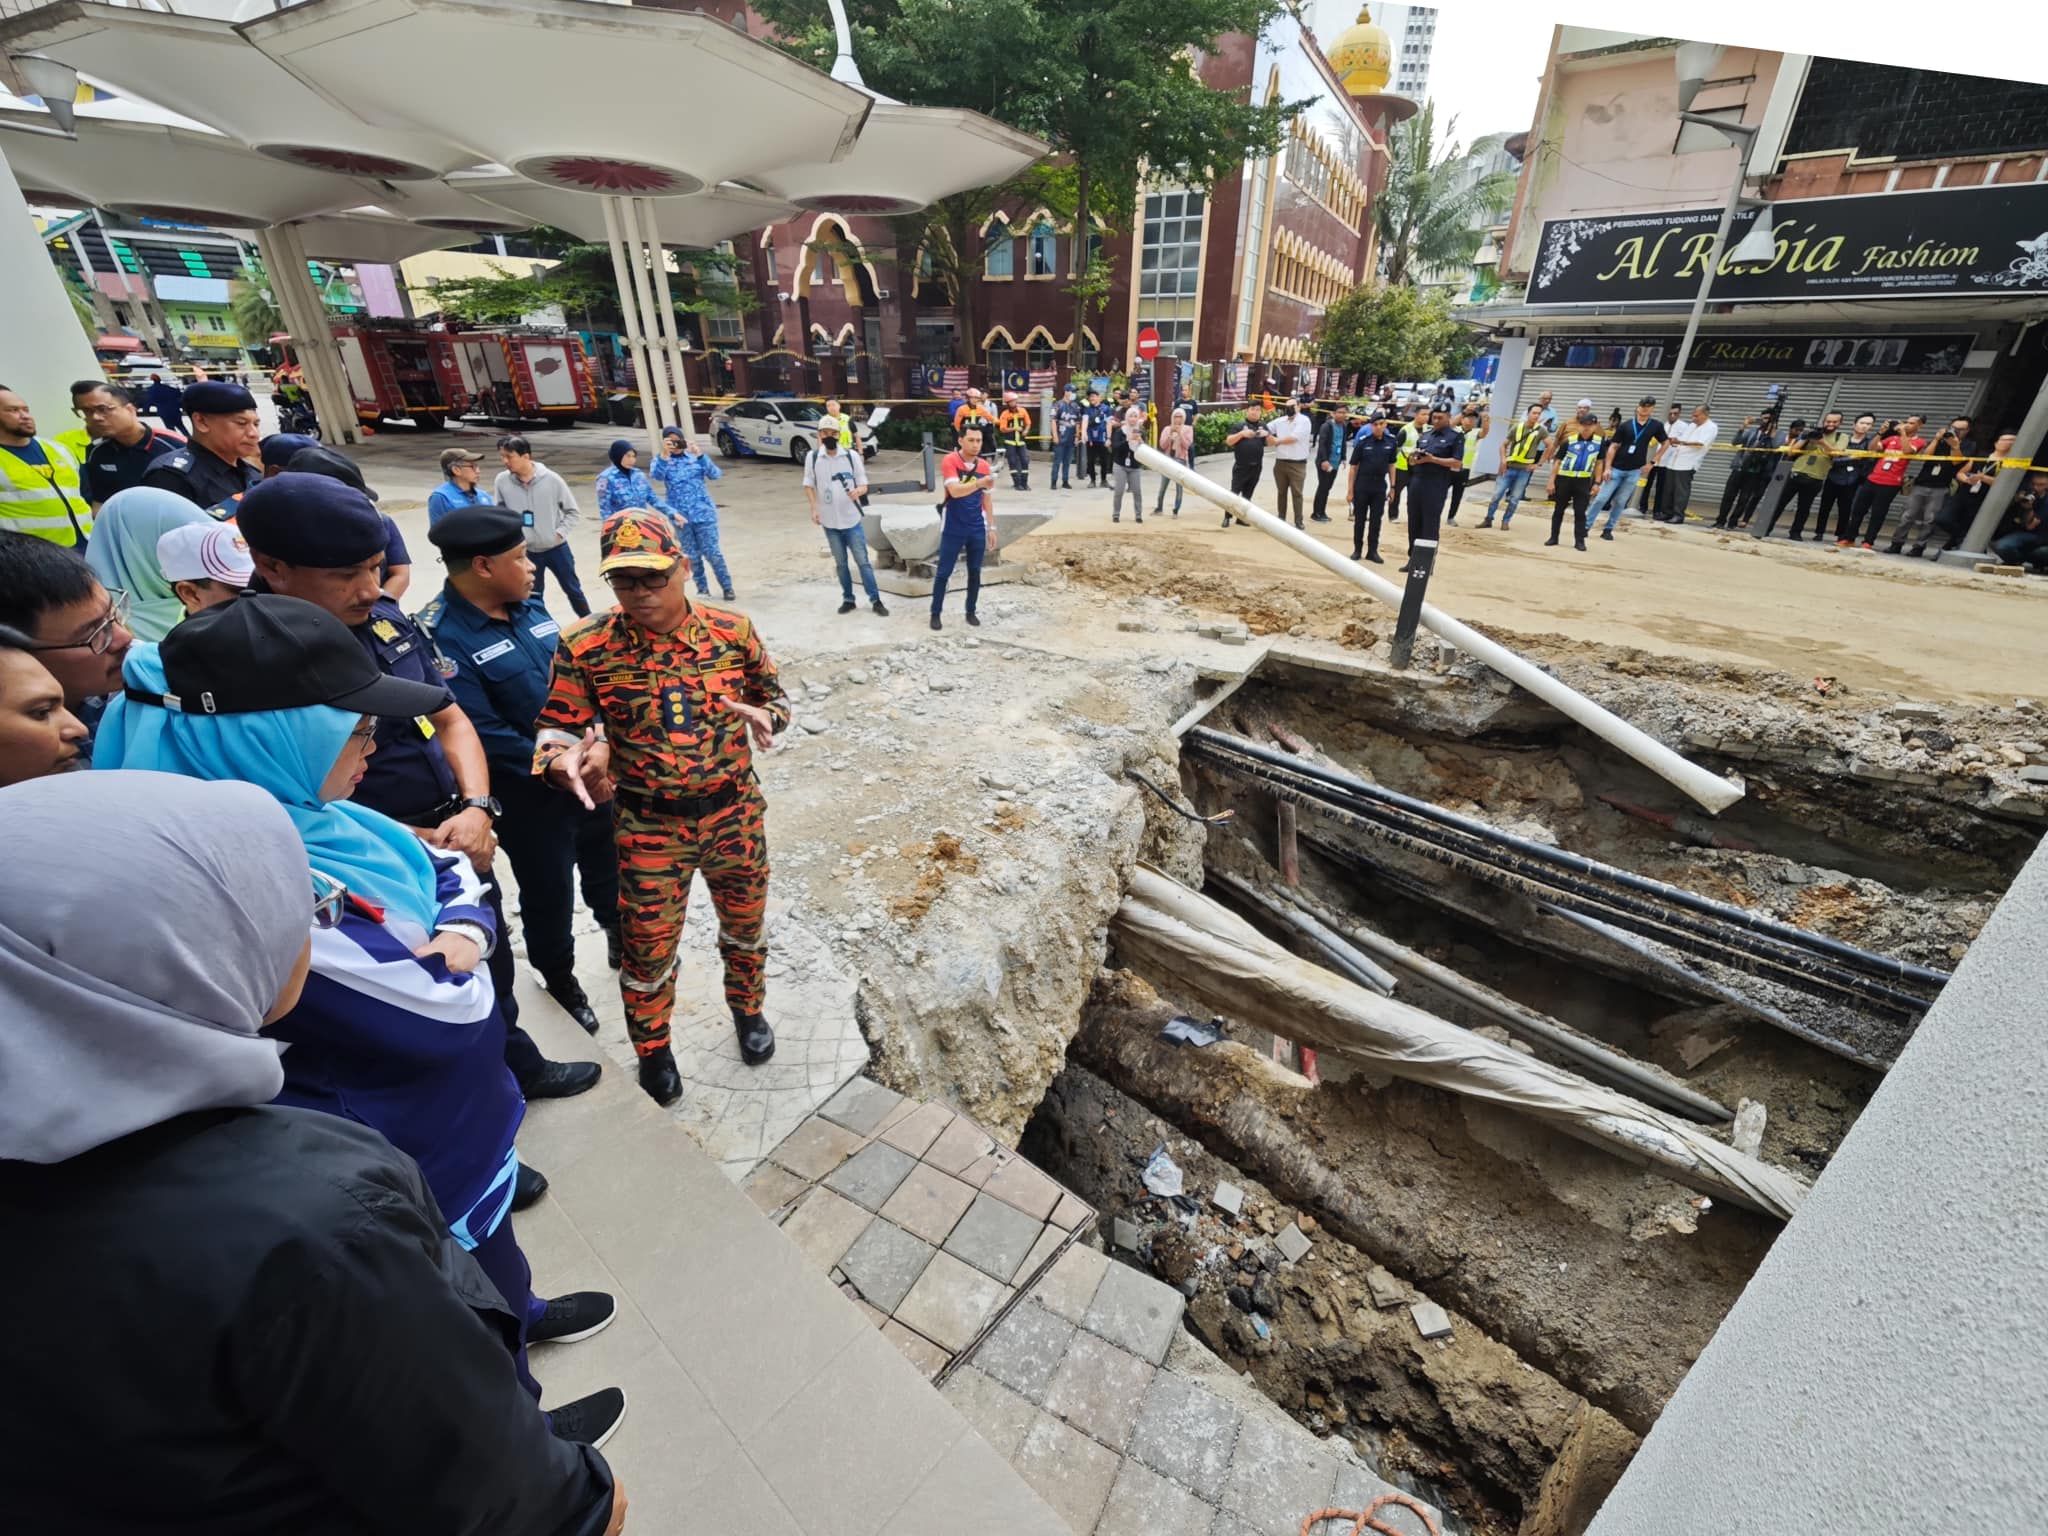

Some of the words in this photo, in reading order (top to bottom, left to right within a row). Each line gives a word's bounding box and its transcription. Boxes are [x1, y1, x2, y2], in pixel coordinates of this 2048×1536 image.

[1612, 216, 1663, 229] PEMBORONG
[1665, 214, 1699, 226] TUDUNG
[1700, 213, 1719, 224] DAN
[1597, 227, 1682, 281] Al
[1851, 240, 1980, 276] Fashion
[1708, 340, 1794, 360] Rabia
[758, 435, 783, 446] POLIS
